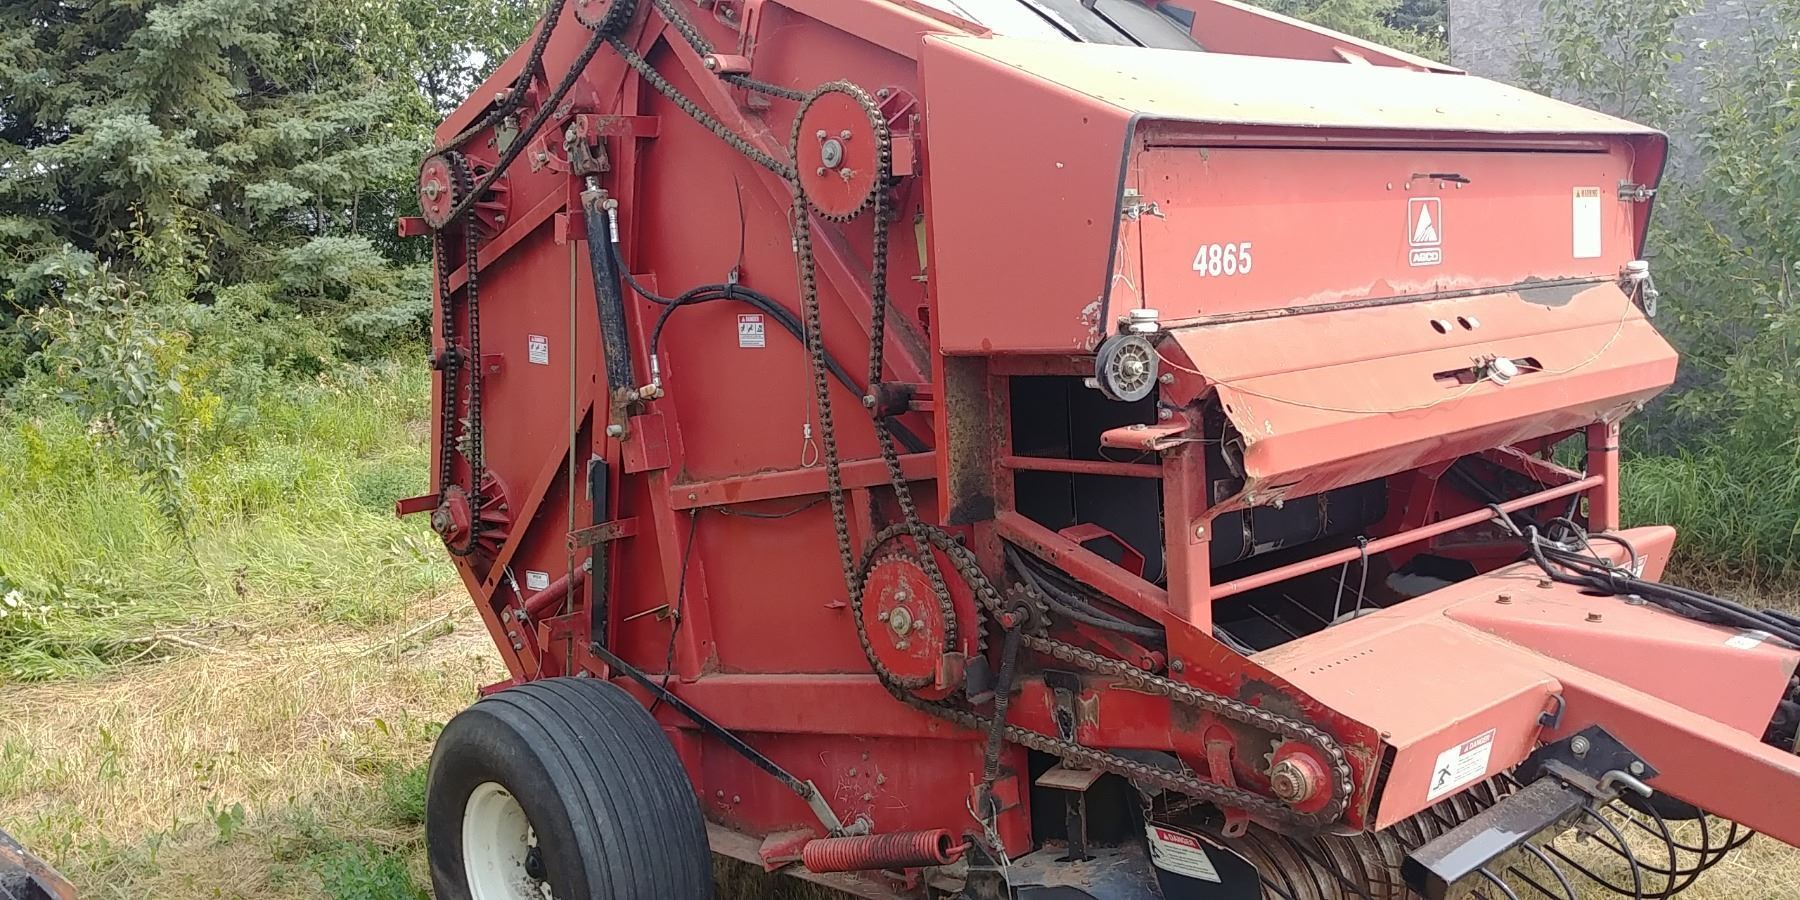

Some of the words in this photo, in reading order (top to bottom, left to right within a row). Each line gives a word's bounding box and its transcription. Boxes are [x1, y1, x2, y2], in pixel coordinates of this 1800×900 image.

[1192, 242, 1252, 277] 4865
[1468, 734, 1491, 750] DANGER
[1168, 833, 1196, 847] DANGER
